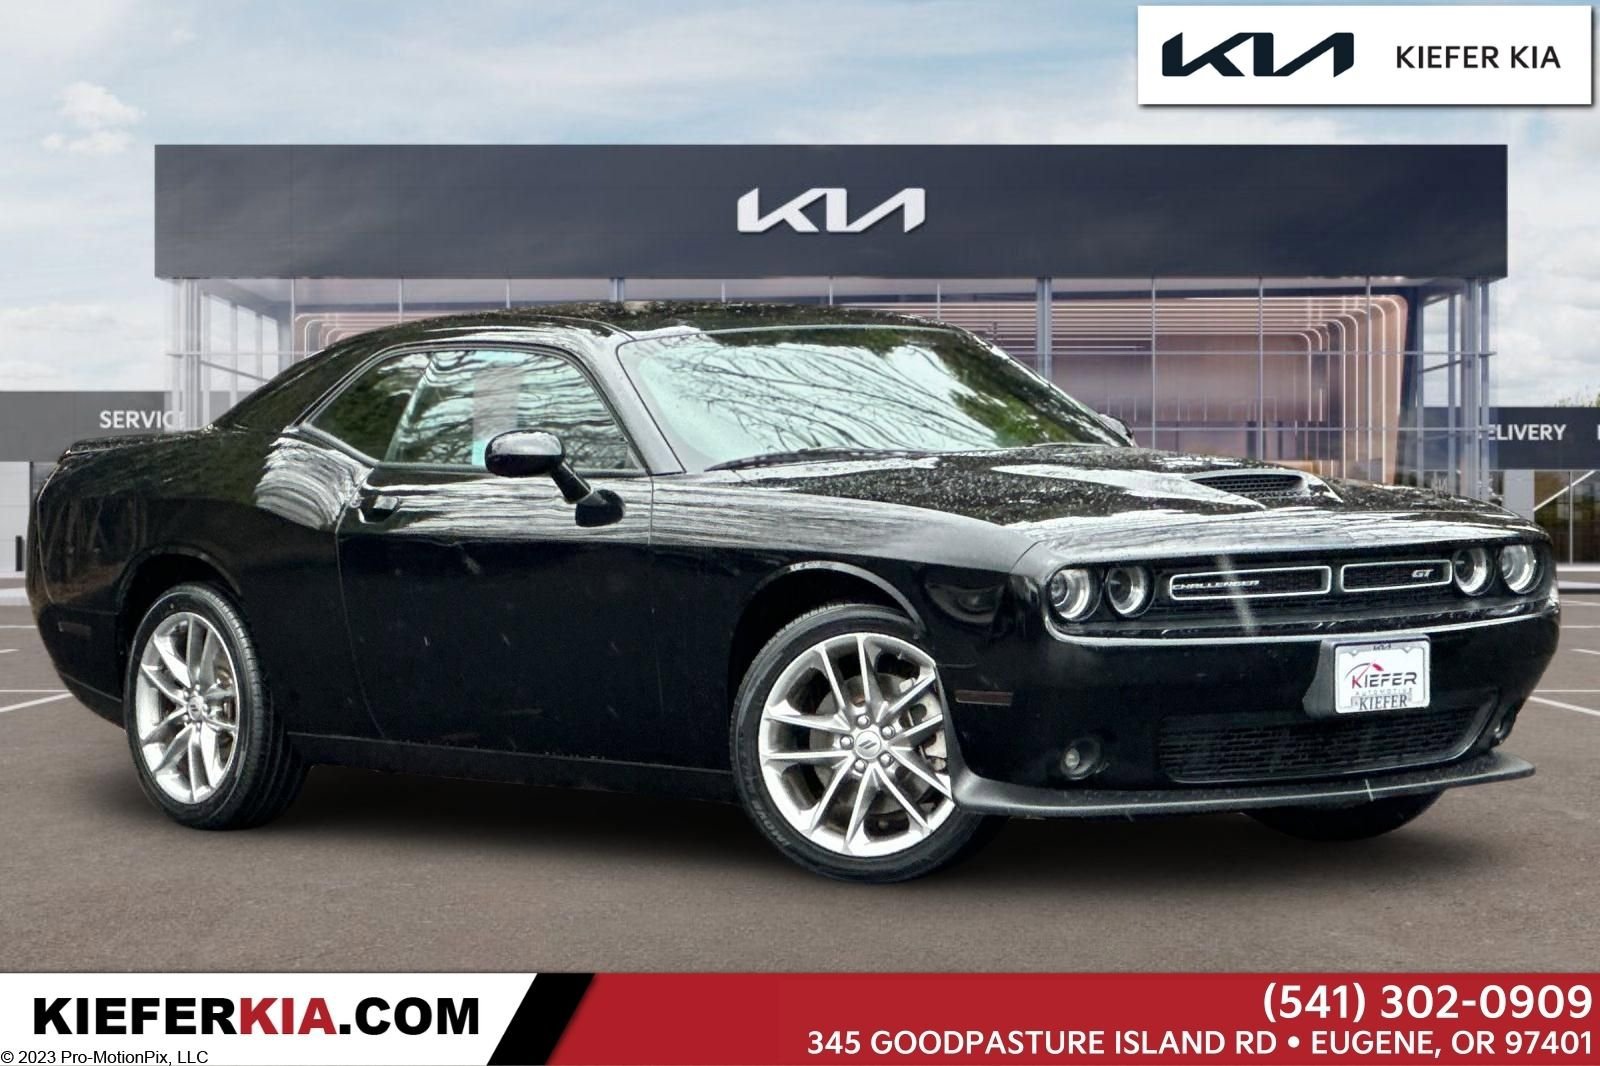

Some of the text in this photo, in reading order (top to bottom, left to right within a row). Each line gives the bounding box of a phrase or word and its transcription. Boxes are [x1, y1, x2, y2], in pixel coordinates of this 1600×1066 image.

[738, 188, 925, 233] KIA
[1478, 423, 1567, 441] ELIVERY
[1411, 569, 1433, 578] GT
[1172, 580, 1260, 590] CHALLENGER
[1352, 672, 1417, 689] KIEFER
[1359, 694, 1408, 711] KIEFER
